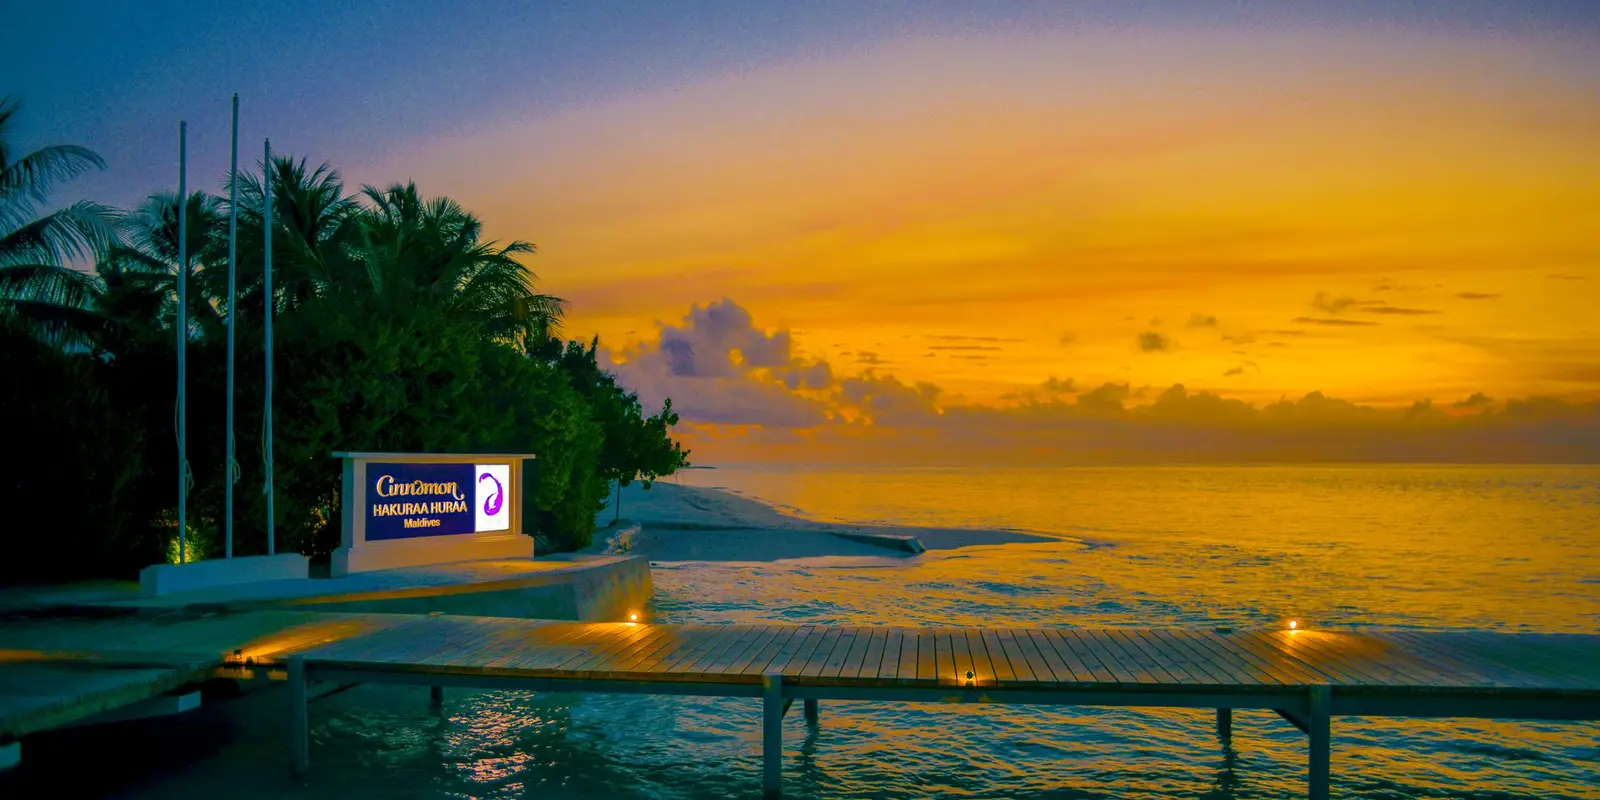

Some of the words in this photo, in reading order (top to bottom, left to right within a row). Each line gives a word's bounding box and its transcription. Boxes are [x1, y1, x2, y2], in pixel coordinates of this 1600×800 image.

[376, 475, 465, 500] Cinnamon
[373, 503, 429, 516] HAKURAA
[431, 501, 468, 515] HURAA
[404, 518, 440, 529] Maldives
